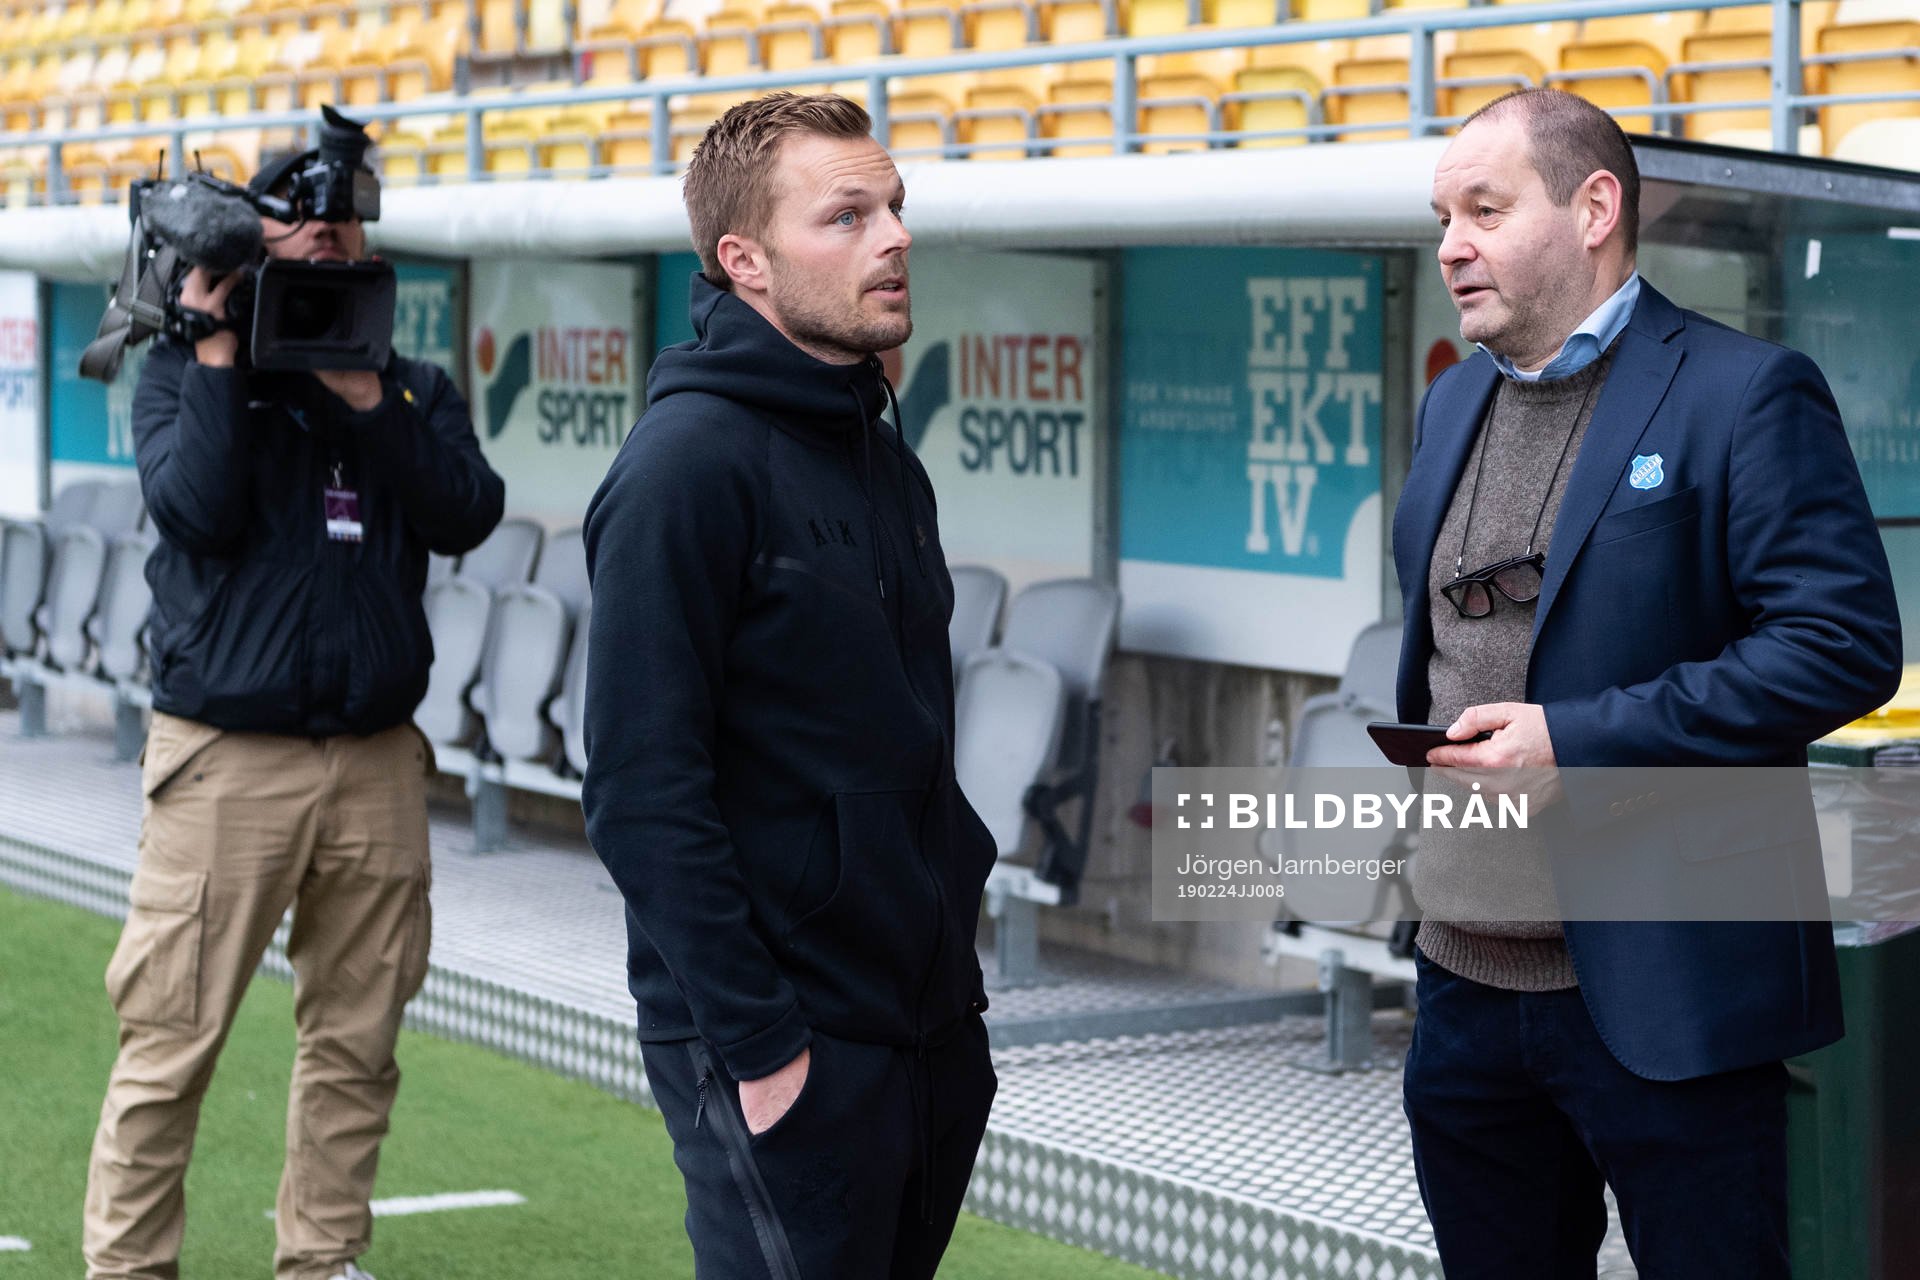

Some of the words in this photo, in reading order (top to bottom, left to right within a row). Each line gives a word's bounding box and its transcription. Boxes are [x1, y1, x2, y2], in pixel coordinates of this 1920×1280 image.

[0, 318, 37, 360] TER
[538, 328, 627, 384] INTER
[1247, 277, 1366, 368] EFF
[960, 335, 1083, 402] INTER
[538, 390, 626, 447] SPORT
[960, 406, 1083, 477] SPORT
[1248, 372, 1381, 466] EKT
[1246, 464, 1317, 555] IV
